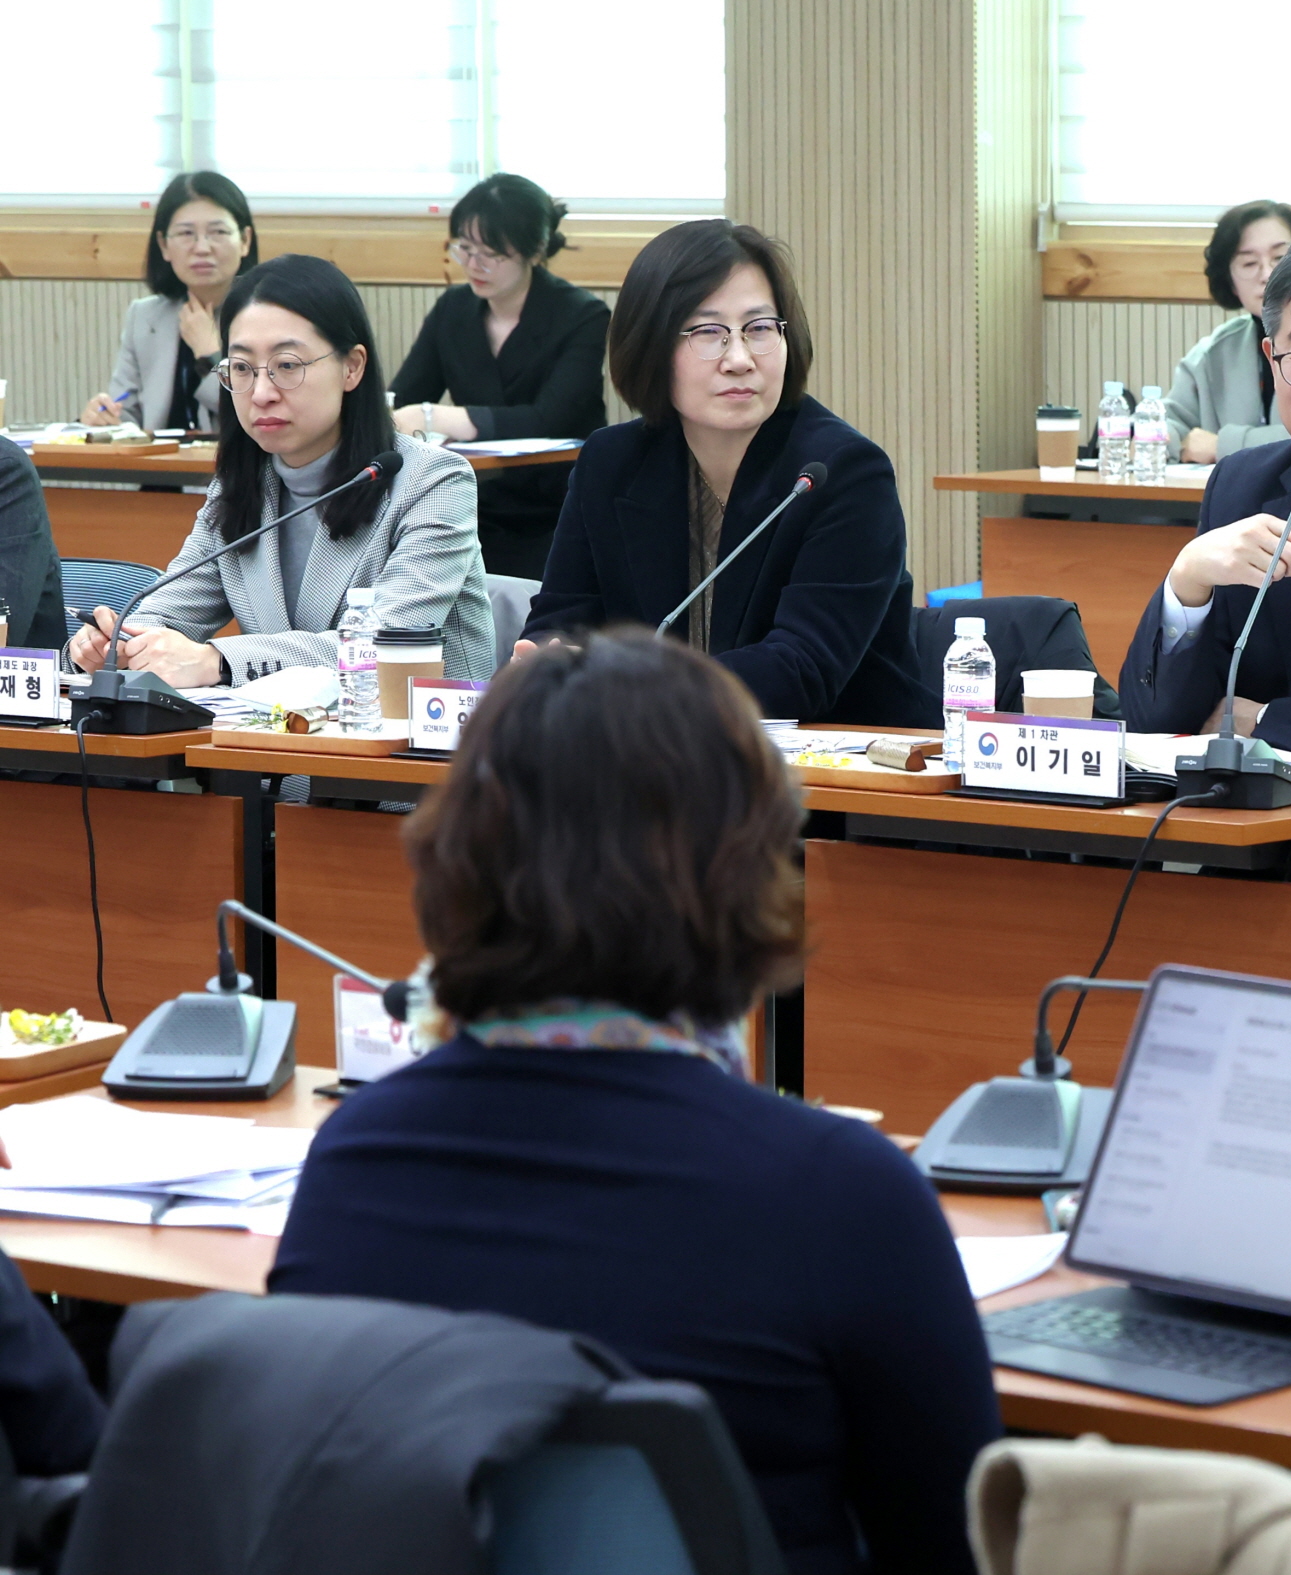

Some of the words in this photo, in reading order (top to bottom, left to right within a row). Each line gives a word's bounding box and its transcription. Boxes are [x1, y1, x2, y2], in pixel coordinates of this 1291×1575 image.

[359, 649, 378, 659] ICIS
[0, 659, 18, 670] 제도
[22, 661, 37, 672] 과장
[947, 684, 965, 694] ICIS
[422, 724, 449, 733] 보건복지부
[1040, 729, 1059, 741] 차관
[973, 760, 1003, 770] 보건복지부
